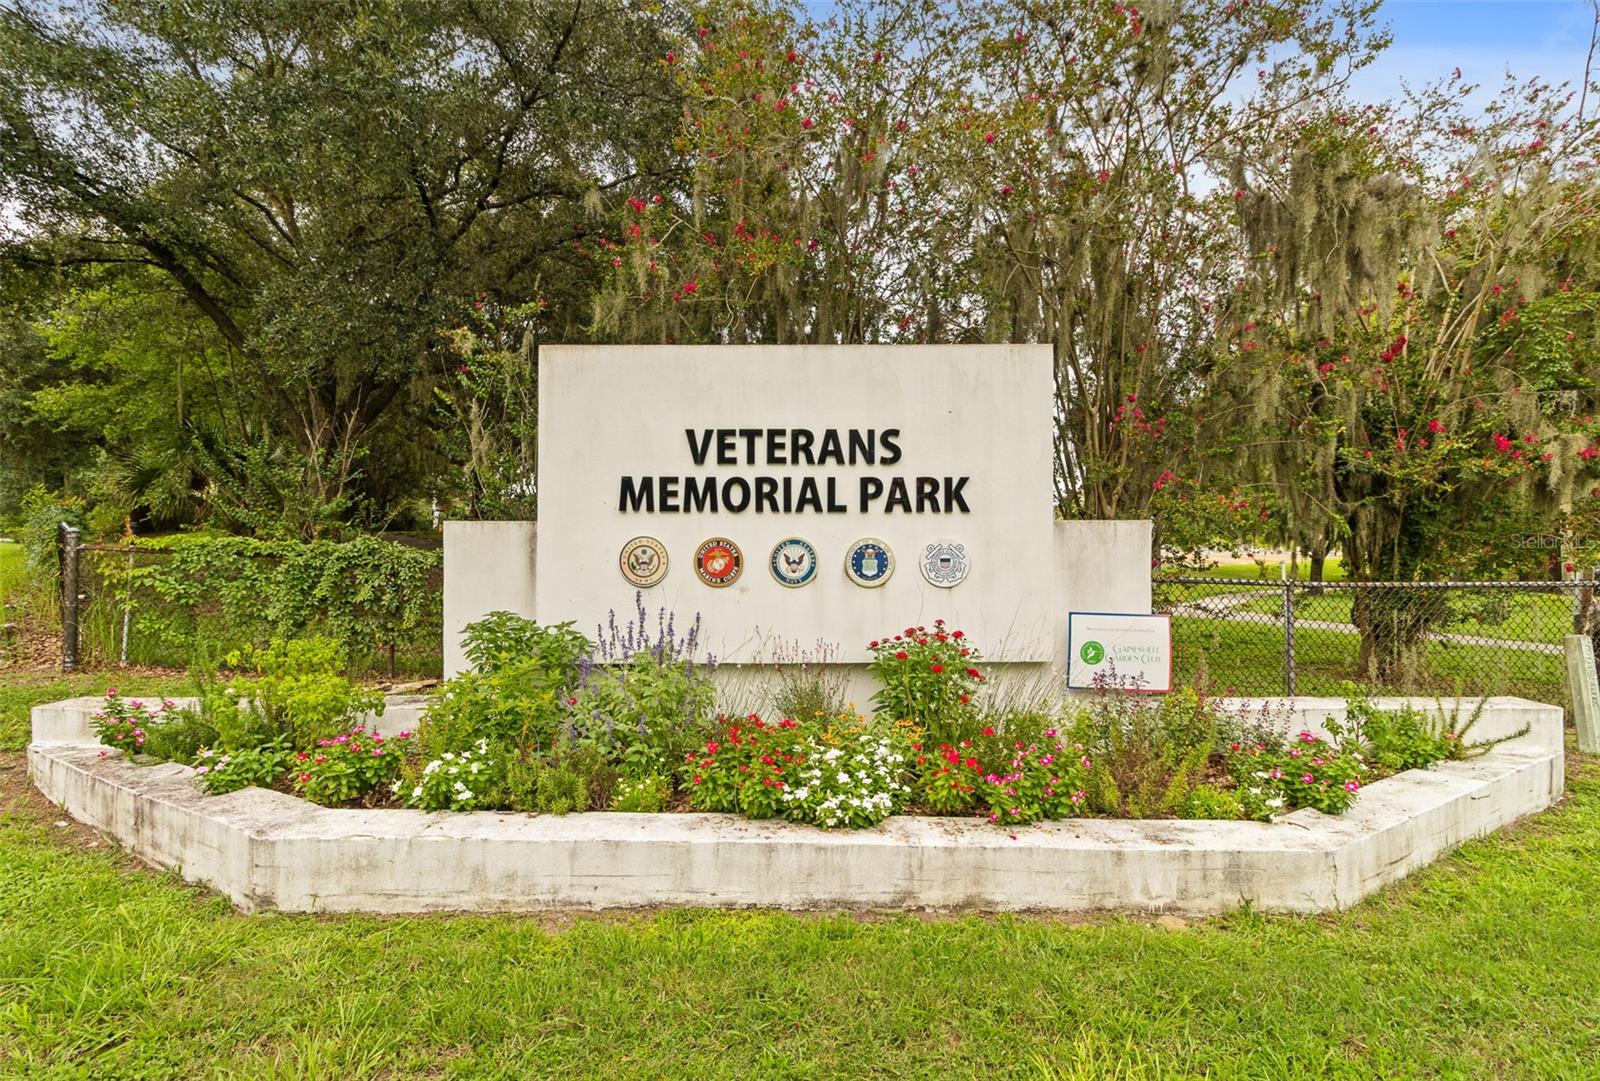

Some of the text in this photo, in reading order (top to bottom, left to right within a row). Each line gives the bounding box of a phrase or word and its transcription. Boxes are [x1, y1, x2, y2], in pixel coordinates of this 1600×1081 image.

[685, 429, 903, 465] VETERANS
[619, 476, 970, 513] MEMORIAL PARK
[698, 541, 738, 558] UNITED STATES
[699, 566, 739, 584] MARINE CORPS
